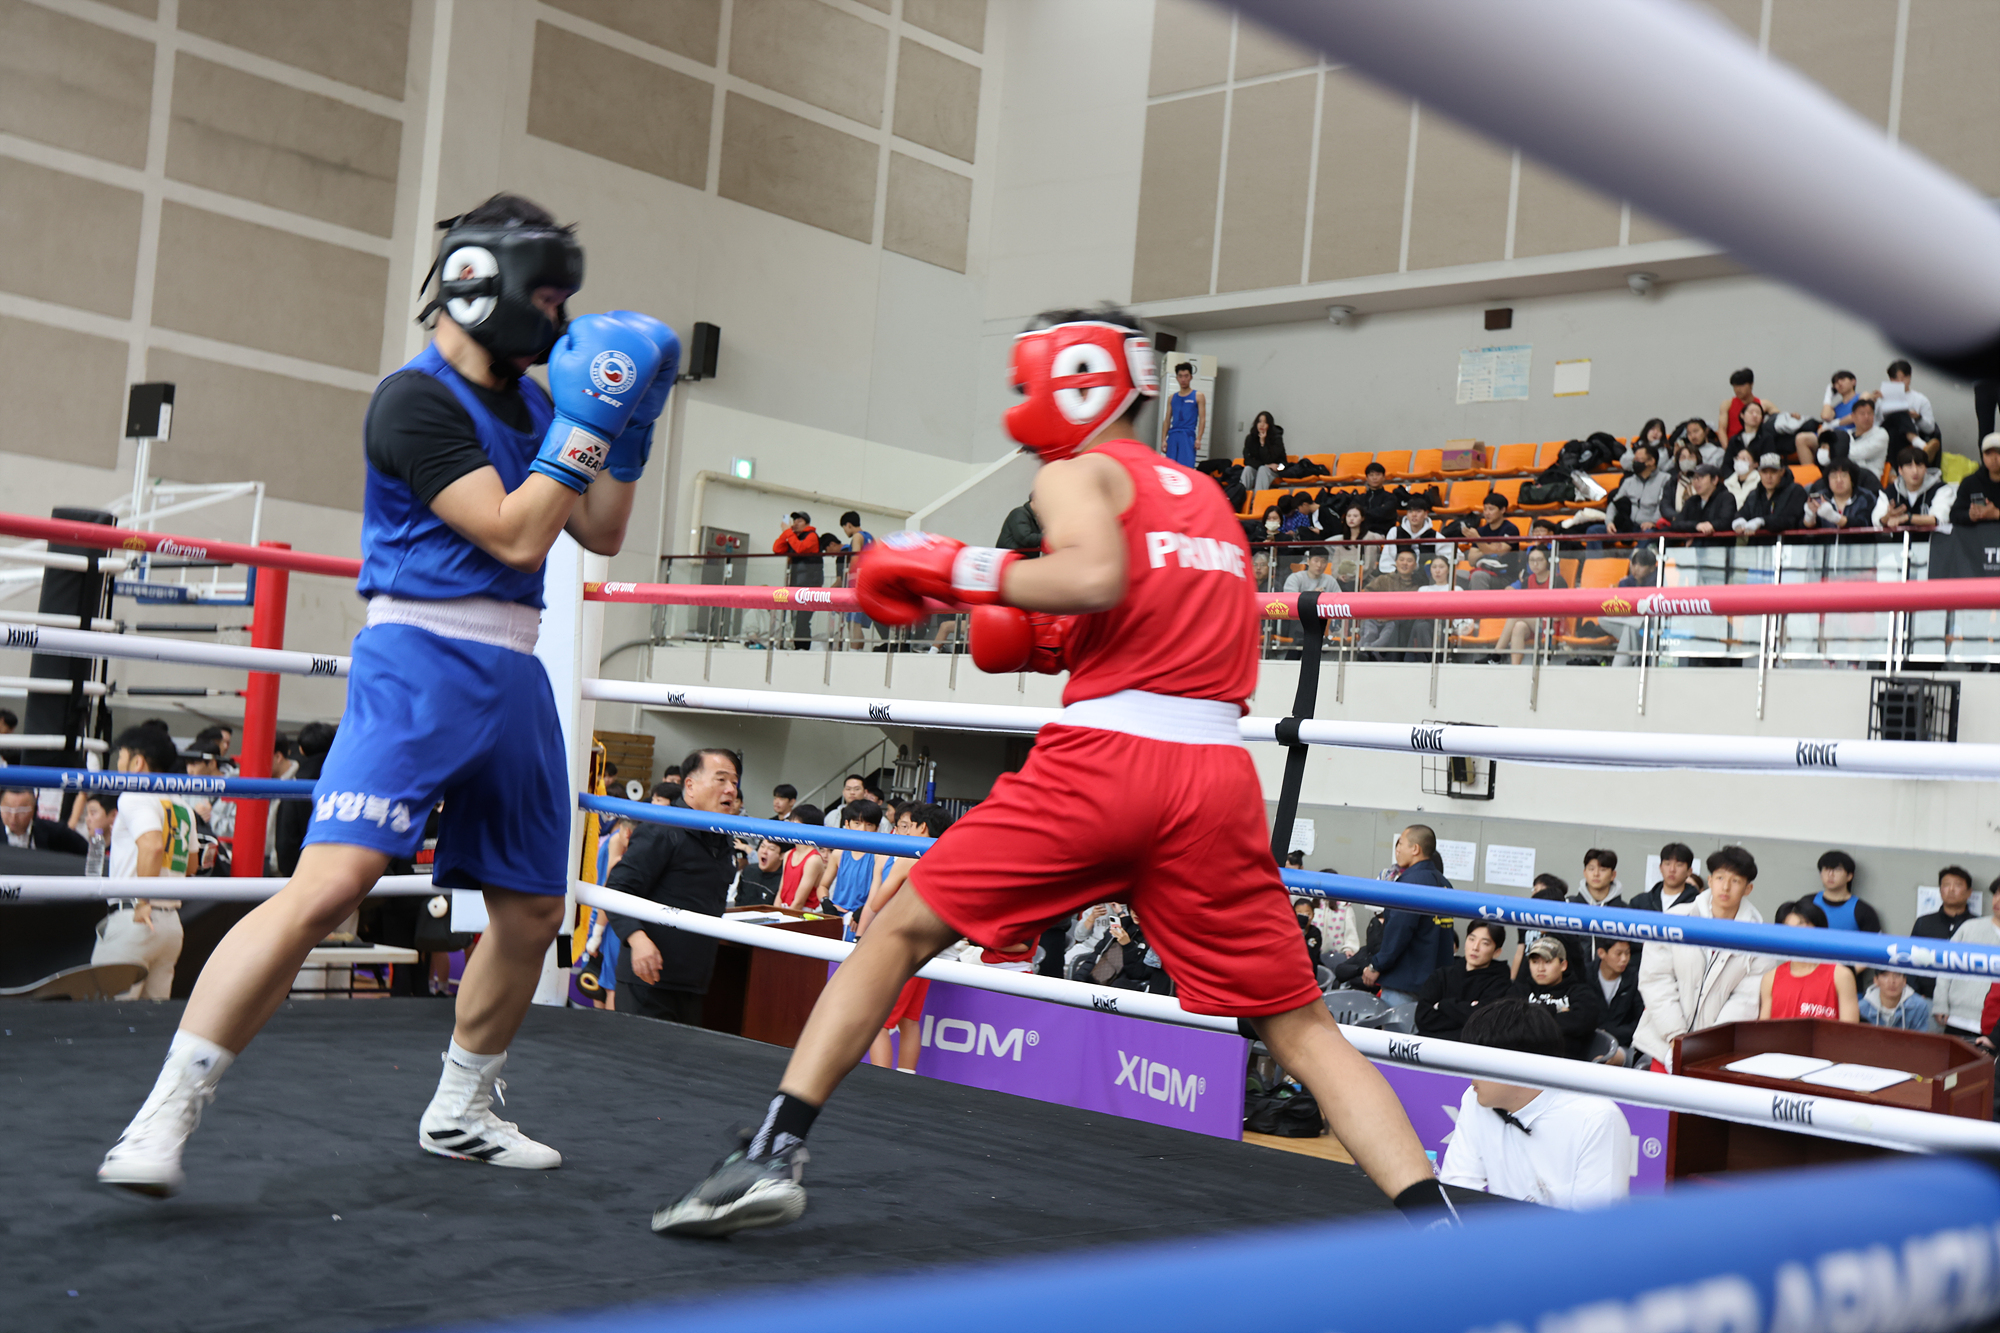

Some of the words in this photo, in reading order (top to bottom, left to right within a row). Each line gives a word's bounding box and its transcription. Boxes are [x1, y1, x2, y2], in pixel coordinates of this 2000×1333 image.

[568, 447, 602, 472] KBEA
[156, 538, 207, 559] Corona
[794, 587, 832, 605] Corona
[1645, 593, 1713, 614] Corona
[1316, 603, 1352, 617] rona
[311, 656, 338, 676] KING
[868, 703, 892, 721] KING
[1411, 726, 1445, 751] KING
[1796, 740, 1838, 767] KING
[89, 774, 151, 791] UNDER
[152, 776, 227, 793] ARMOUR
[1511, 911, 1583, 930] UNDER
[1588, 919, 1684, 941] ARMOUR
[1092, 994, 1119, 1012] KING
[1389, 1038, 1423, 1061] KING
[1772, 1095, 1815, 1125] KING
